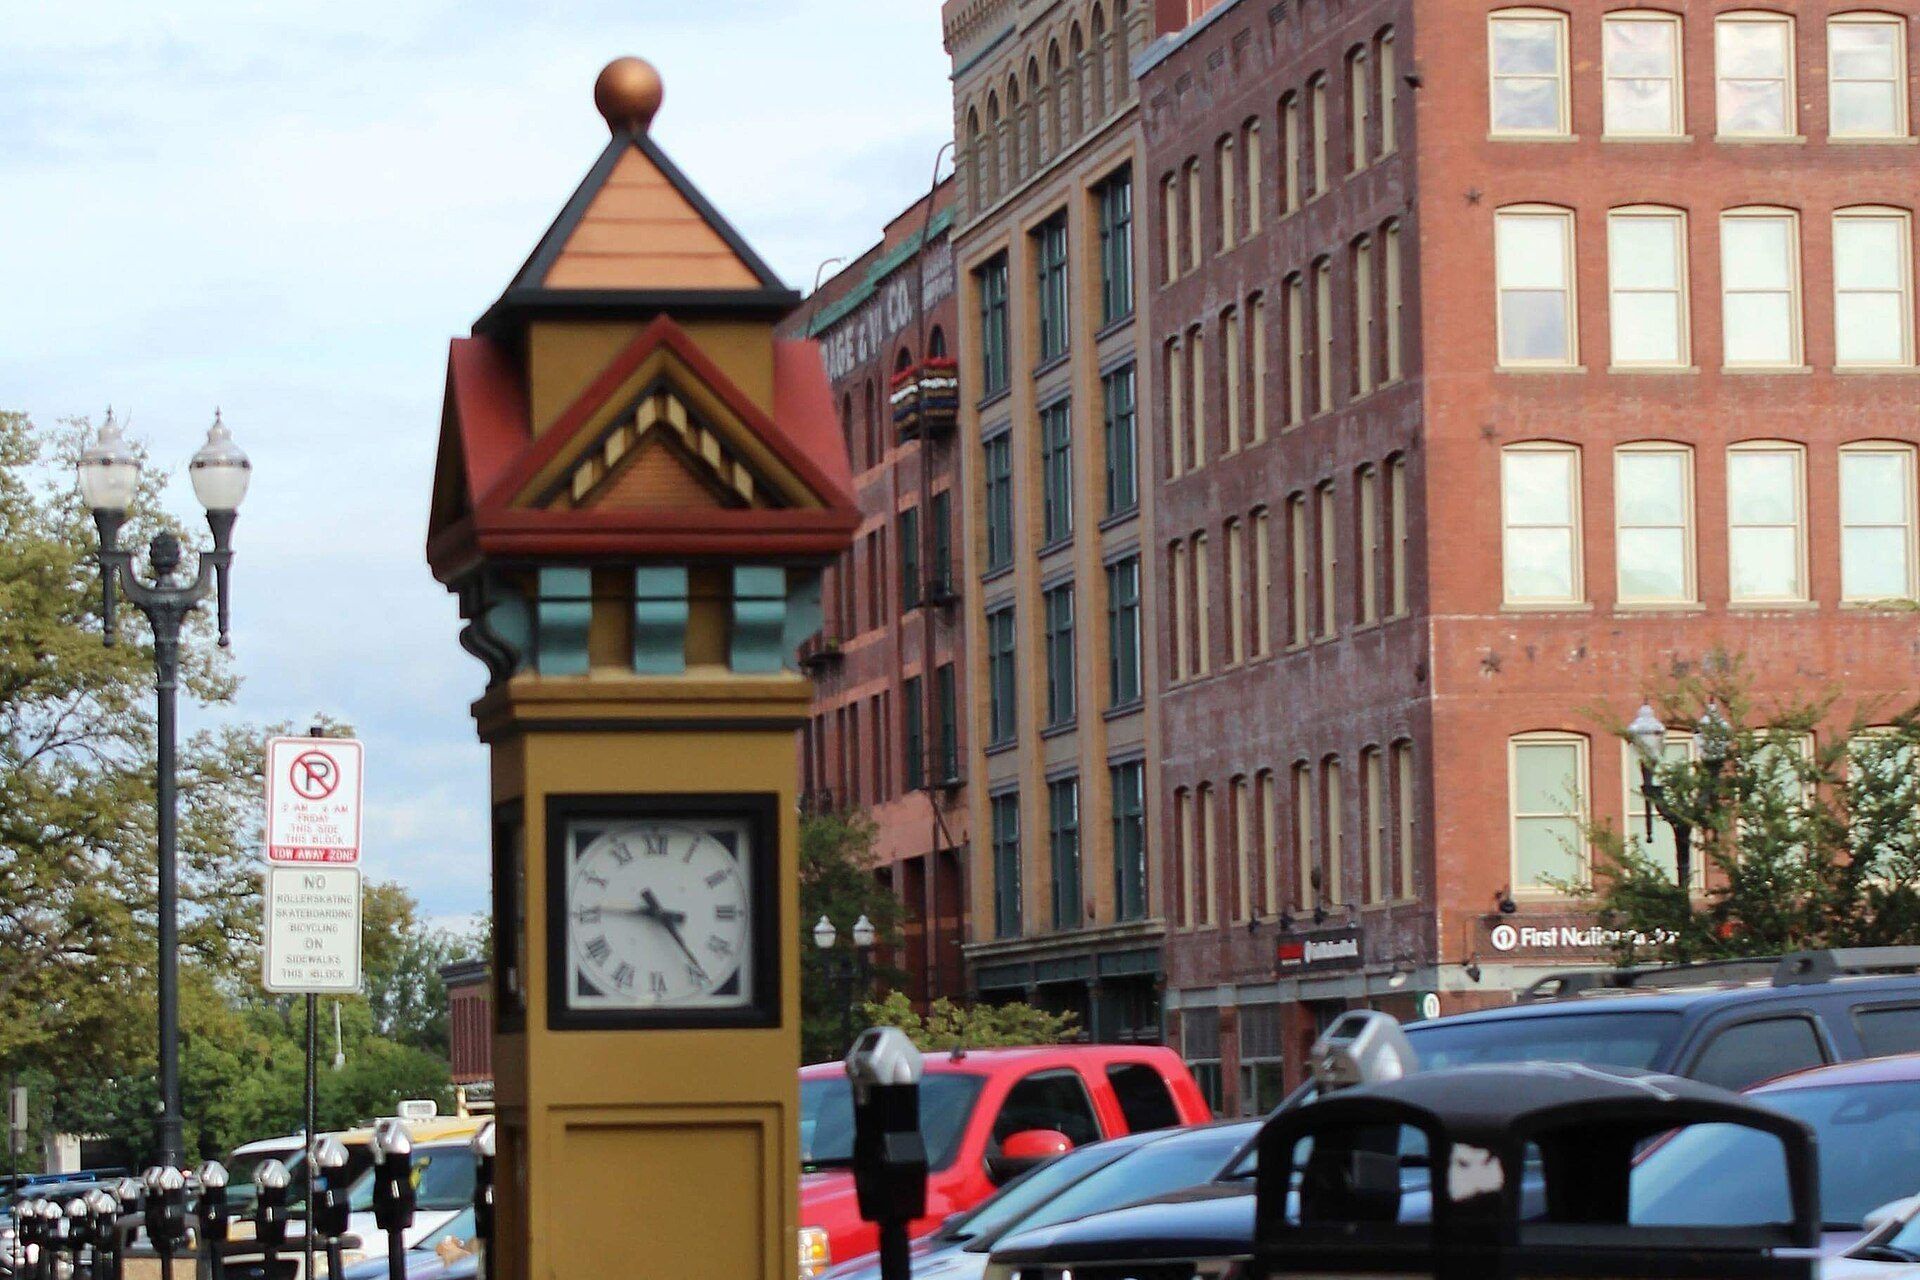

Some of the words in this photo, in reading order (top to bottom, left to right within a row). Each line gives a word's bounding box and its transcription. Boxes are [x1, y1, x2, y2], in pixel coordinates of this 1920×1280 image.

[335, 804, 349, 813] AM
[292, 823, 312, 833] THIS
[318, 824, 338, 834] SIDE
[286, 833, 305, 844] THIS
[311, 834, 344, 845] BLOCK
[273, 847, 294, 859] TOW
[298, 848, 326, 860] AWAY
[329, 848, 357, 861] ZONE
[304, 874, 326, 890] NO
[276, 894, 353, 905] ROLLERSKATING
[275, 908, 354, 920] SKATEBOARDING
[289, 922, 339, 934] BICYCLING
[1521, 926, 1558, 947] First
[304, 936, 324, 951] ON
[286, 954, 342, 965] SIDEWALKS
[281, 968, 304, 979] THIS
[312, 969, 345, 980] BLOCK
